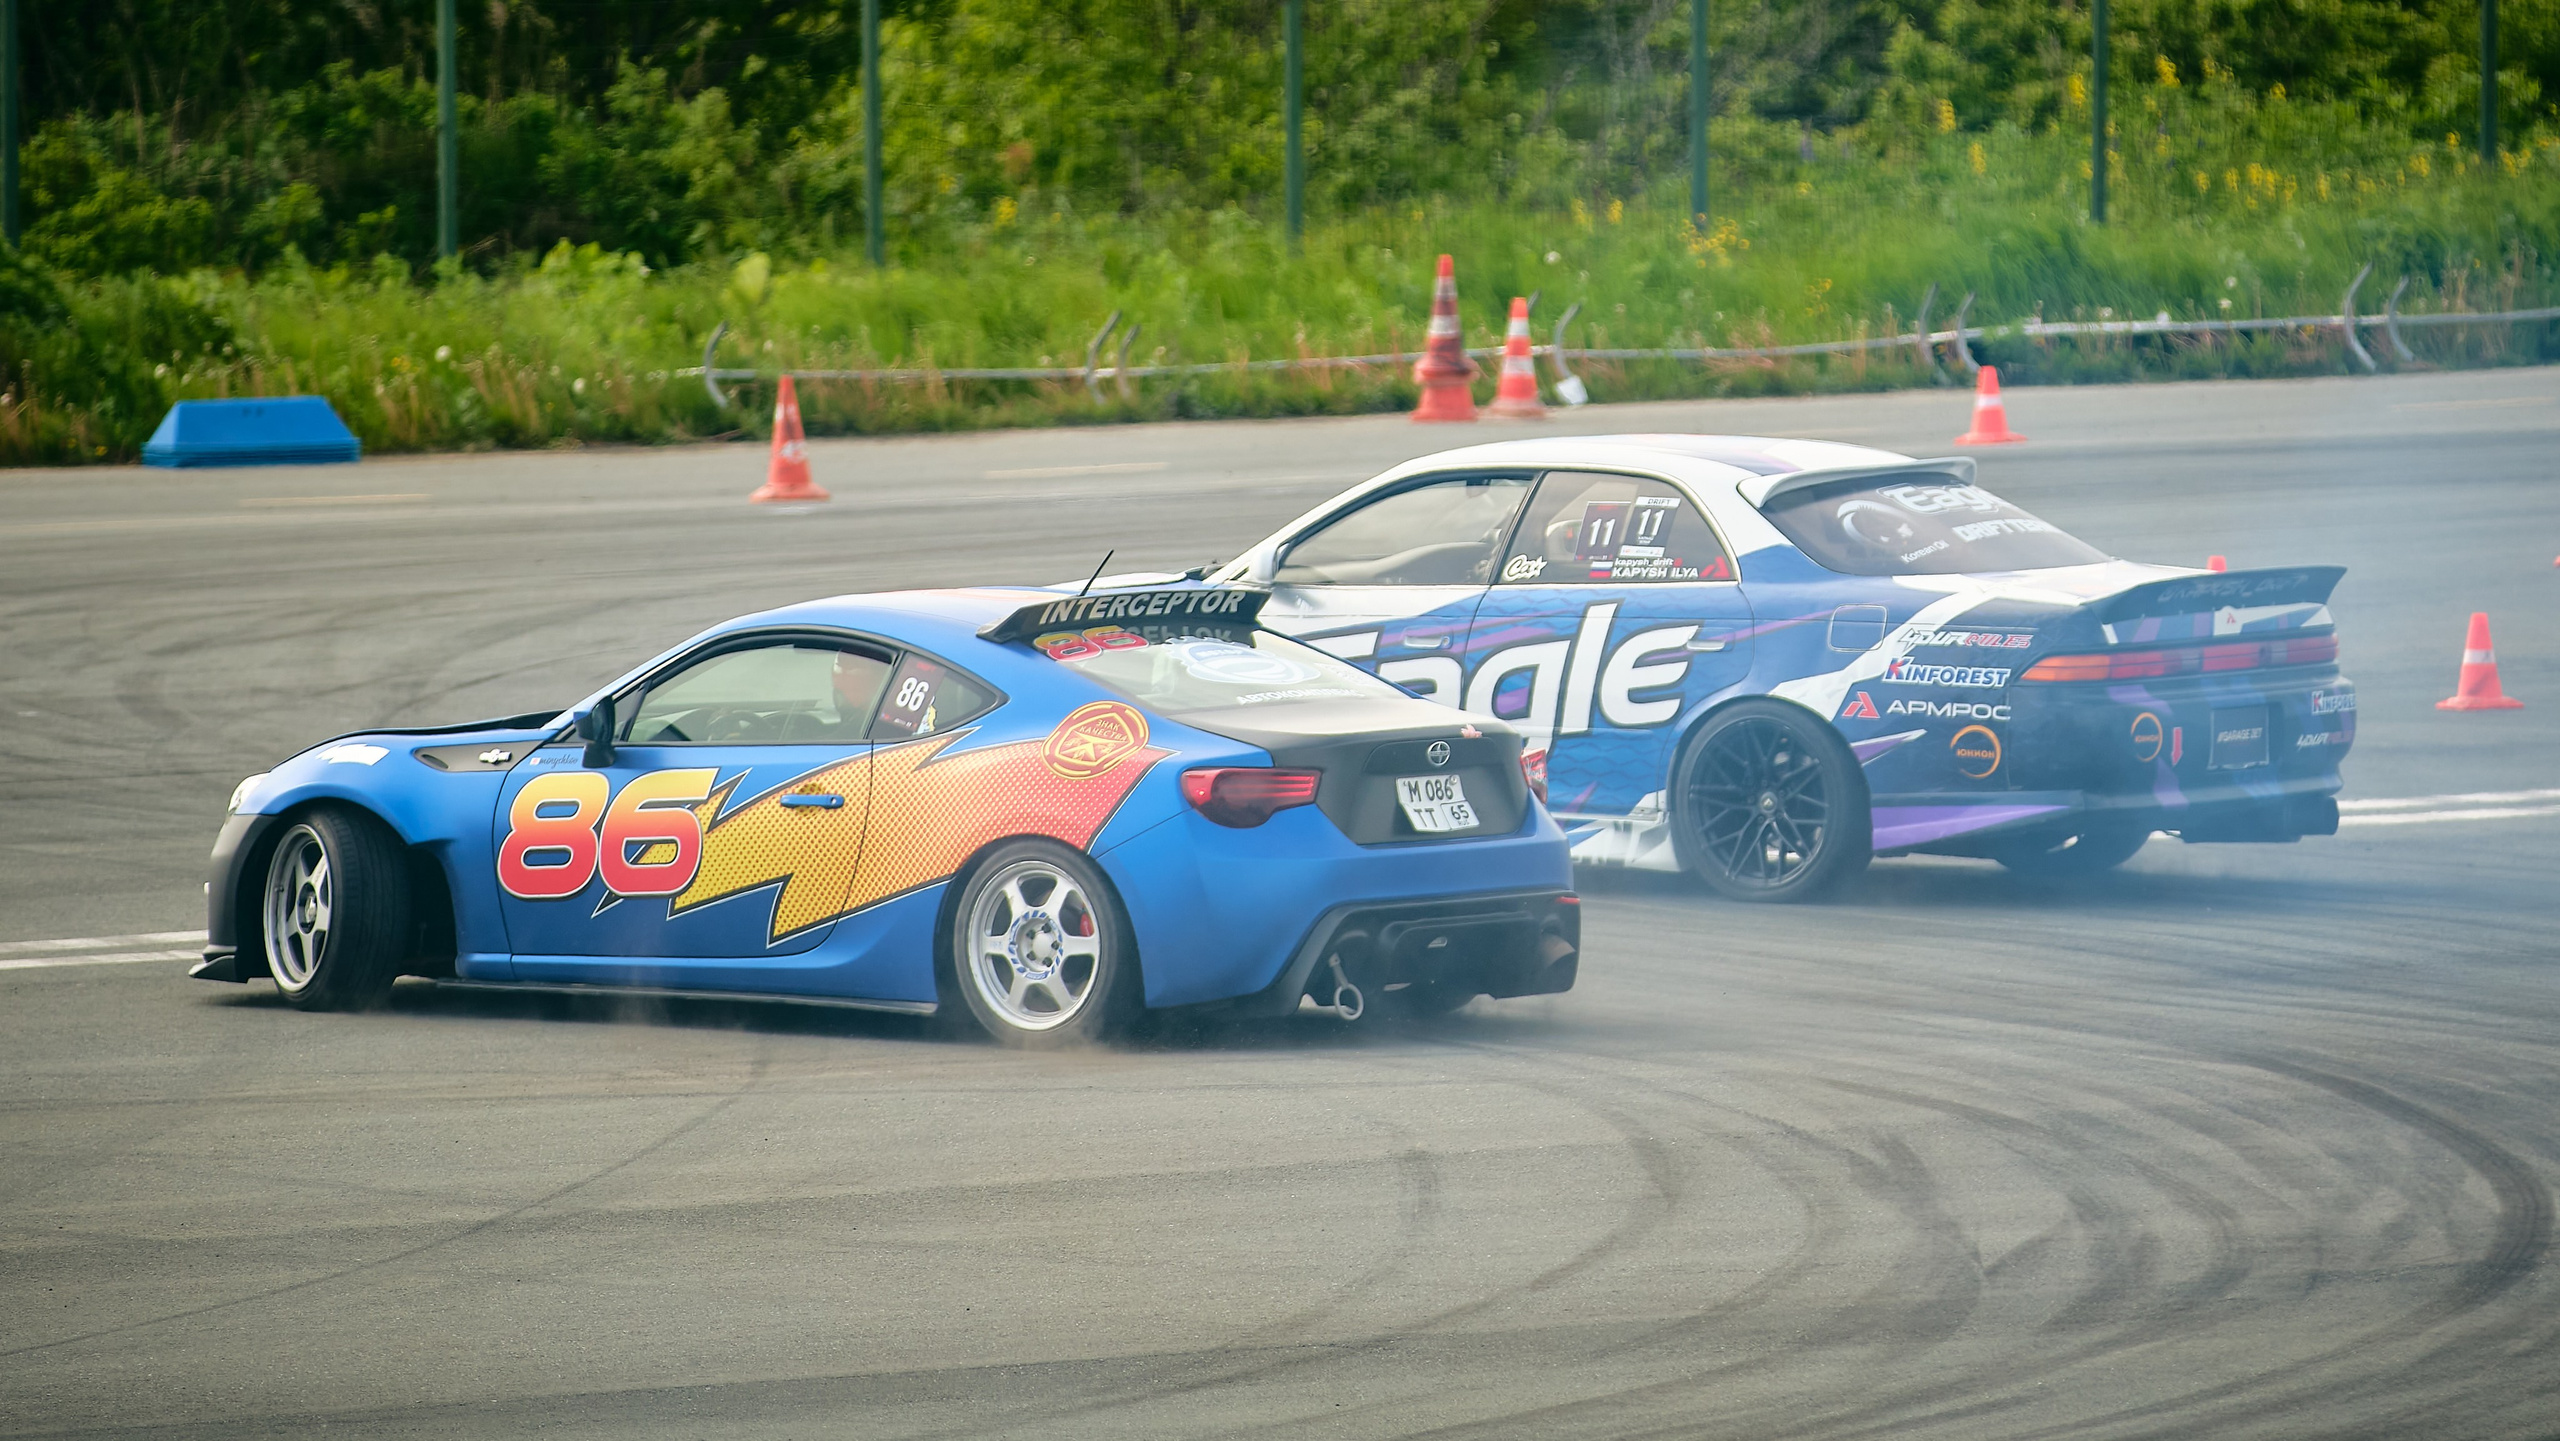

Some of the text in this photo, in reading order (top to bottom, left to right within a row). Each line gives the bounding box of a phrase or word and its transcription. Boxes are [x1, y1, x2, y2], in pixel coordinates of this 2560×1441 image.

[1590, 518, 1616, 547] 11
[1638, 508, 1665, 536] 11
[1615, 558, 1675, 567] kapysh_drift
[1901, 544, 1937, 564] Korean
[1612, 568, 1699, 577] KAPYSH ILYA
[1038, 590, 1247, 625] INTERCEPTOR
[1033, 625, 1149, 662] 86
[1884, 657, 2010, 687] KINFOREST
[896, 677, 929, 711] 86
[1887, 700, 2011, 719] АРМРОС
[1080, 726, 1127, 741] КАЧЕСТВА
[1096, 719, 1120, 731] ЗНАК
[1425, 778, 1454, 801] 086
[1450, 804, 1469, 820] 65
[498, 768, 719, 899] 86
